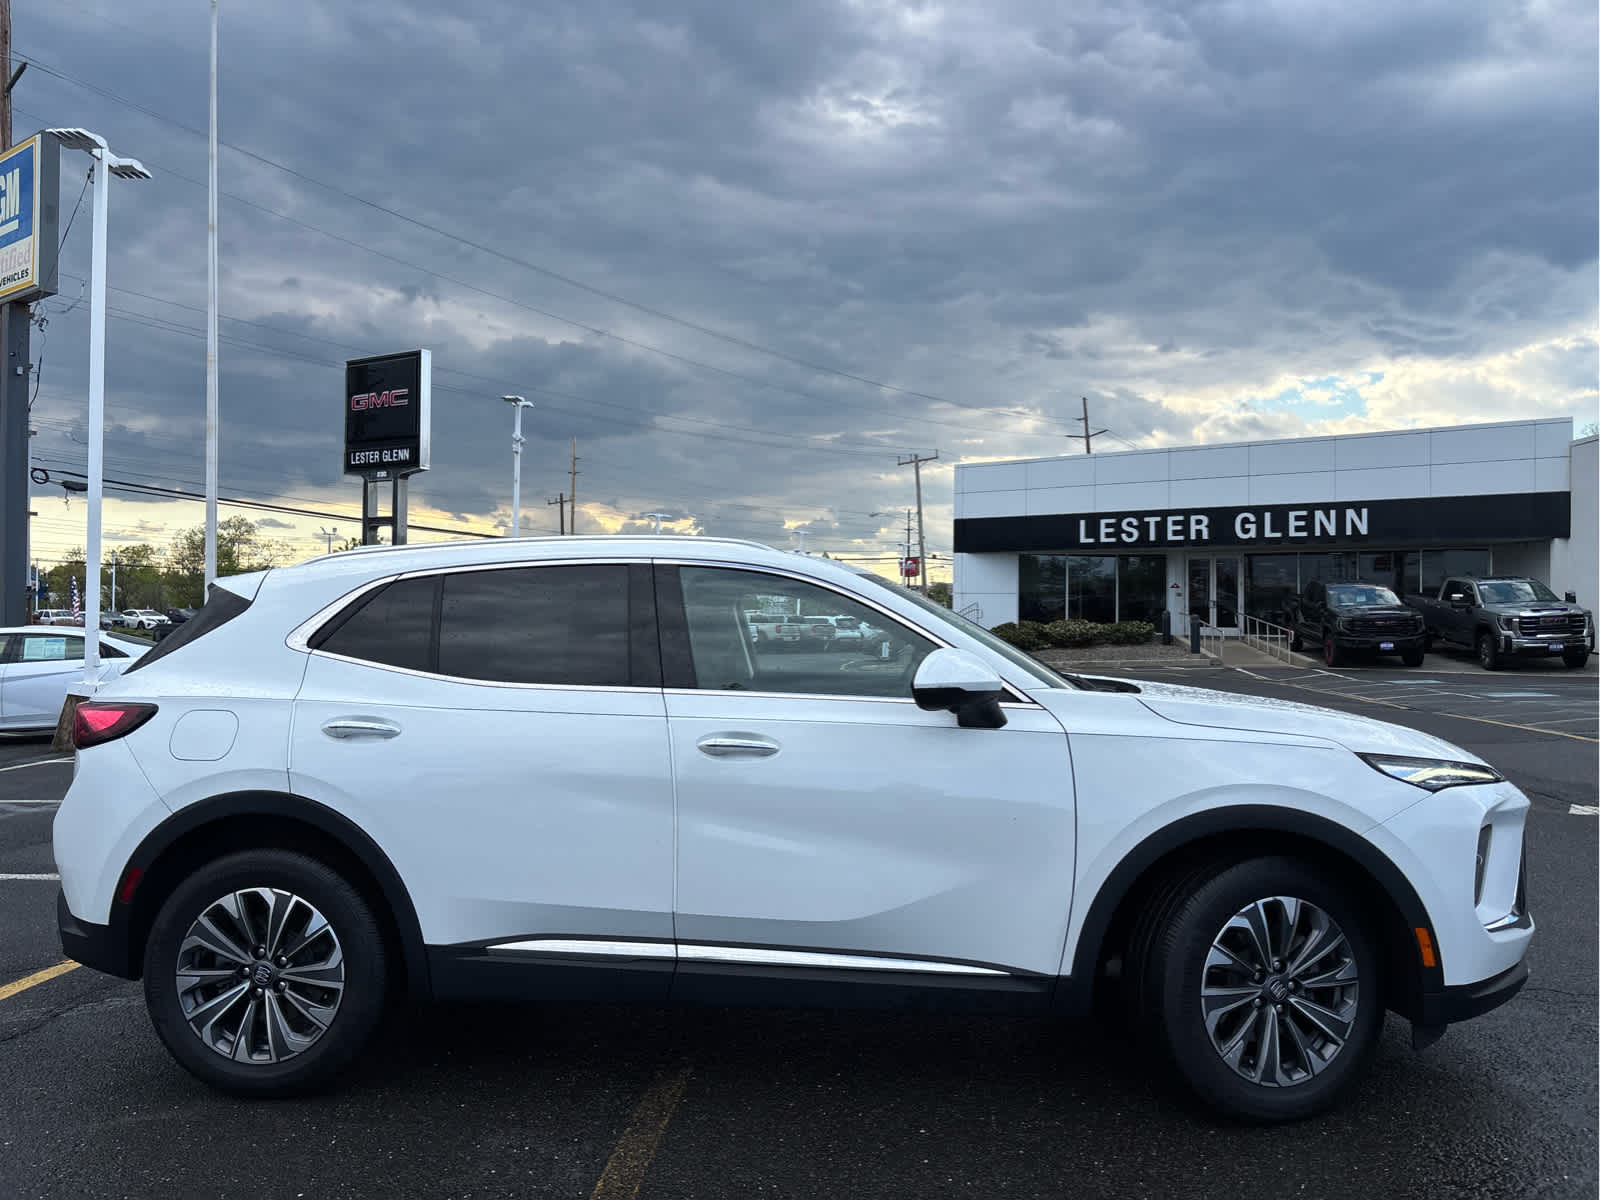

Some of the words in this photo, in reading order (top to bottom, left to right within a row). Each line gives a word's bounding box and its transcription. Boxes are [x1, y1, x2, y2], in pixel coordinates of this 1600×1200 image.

[351, 389, 409, 411] GMC
[351, 450, 380, 465] LESTER
[382, 448, 410, 462] GLENN
[1079, 514, 1210, 543] LESTER
[1234, 508, 1369, 540] GLENN
